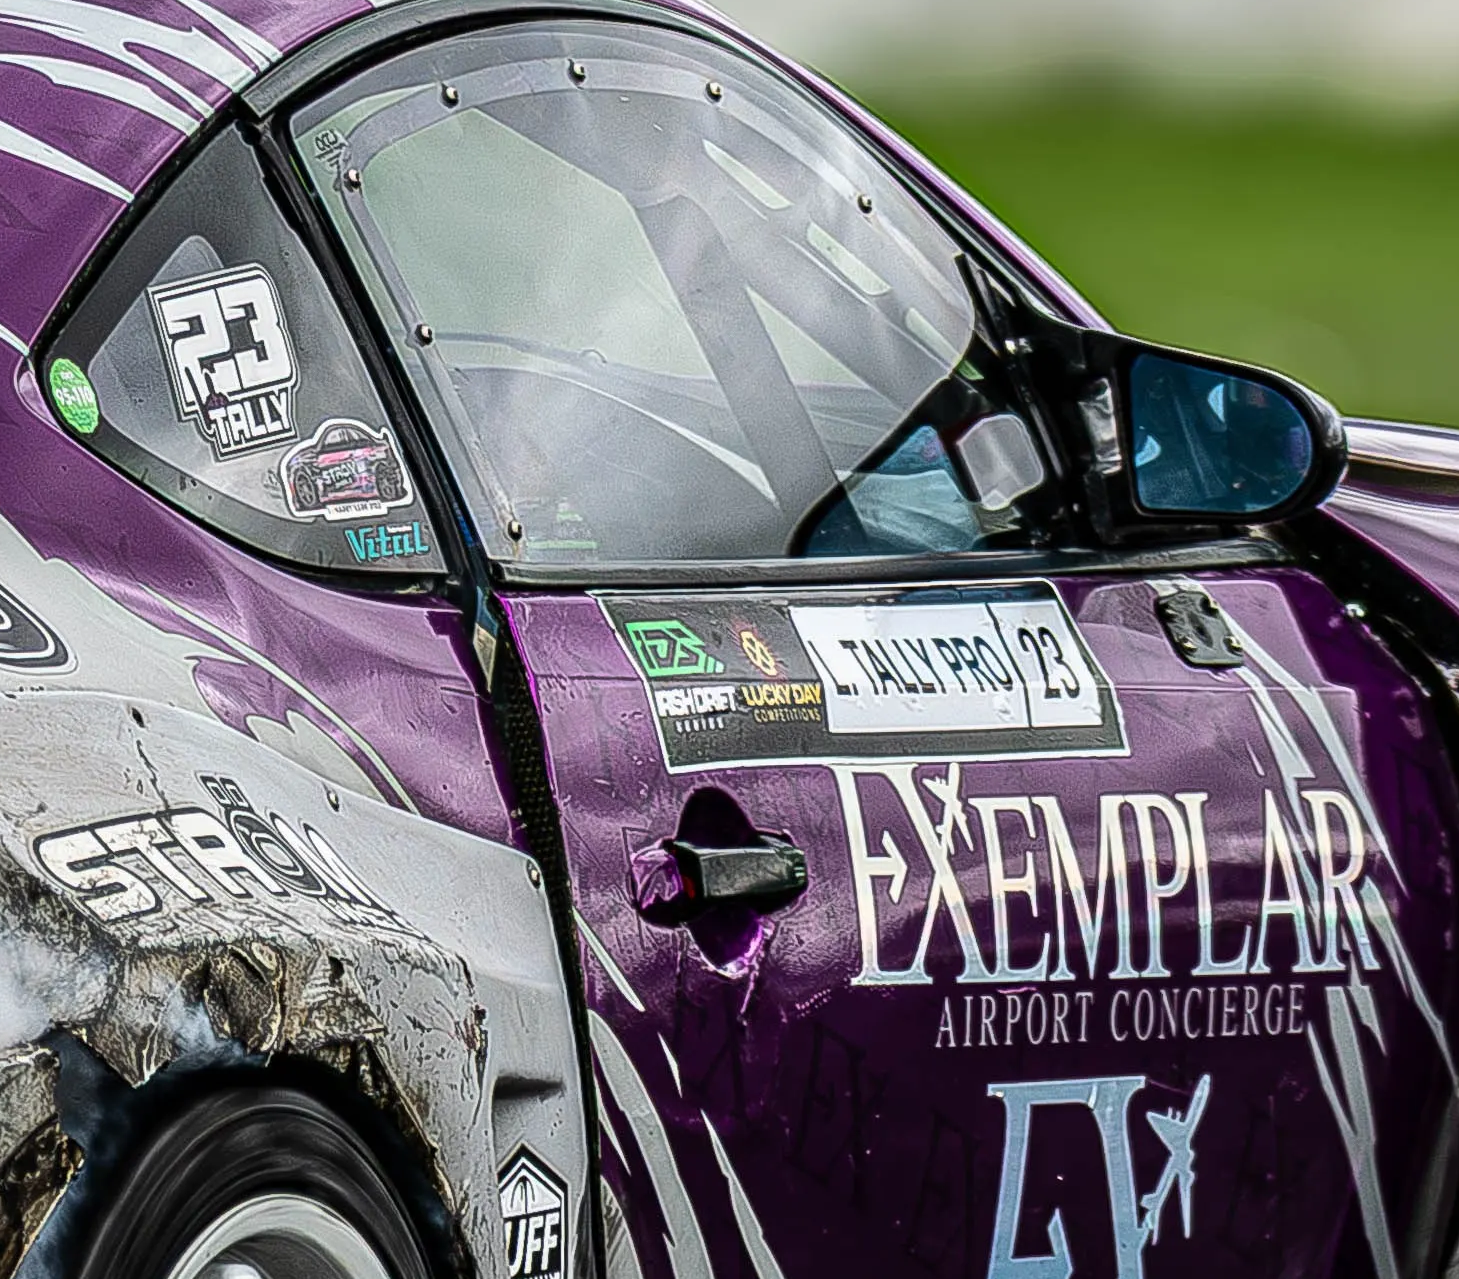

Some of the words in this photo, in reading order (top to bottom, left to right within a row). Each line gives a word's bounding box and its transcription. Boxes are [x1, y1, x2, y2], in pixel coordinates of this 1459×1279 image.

[159, 277, 292, 404] 23
[208, 391, 290, 445] TALLY
[740, 683, 791, 707] LUCKY
[790, 683, 822, 706] DAY
[840, 639, 947, 695] TALLY
[930, 636, 1013, 694] PRO
[1018, 626, 1081, 699] 23
[754, 707, 822, 723] COMPETITIONS
[935, 990, 1095, 1049] AIRPORT
[1110, 983, 1306, 1042] CONCIERGE
[504, 1212, 561, 1278] UFF
